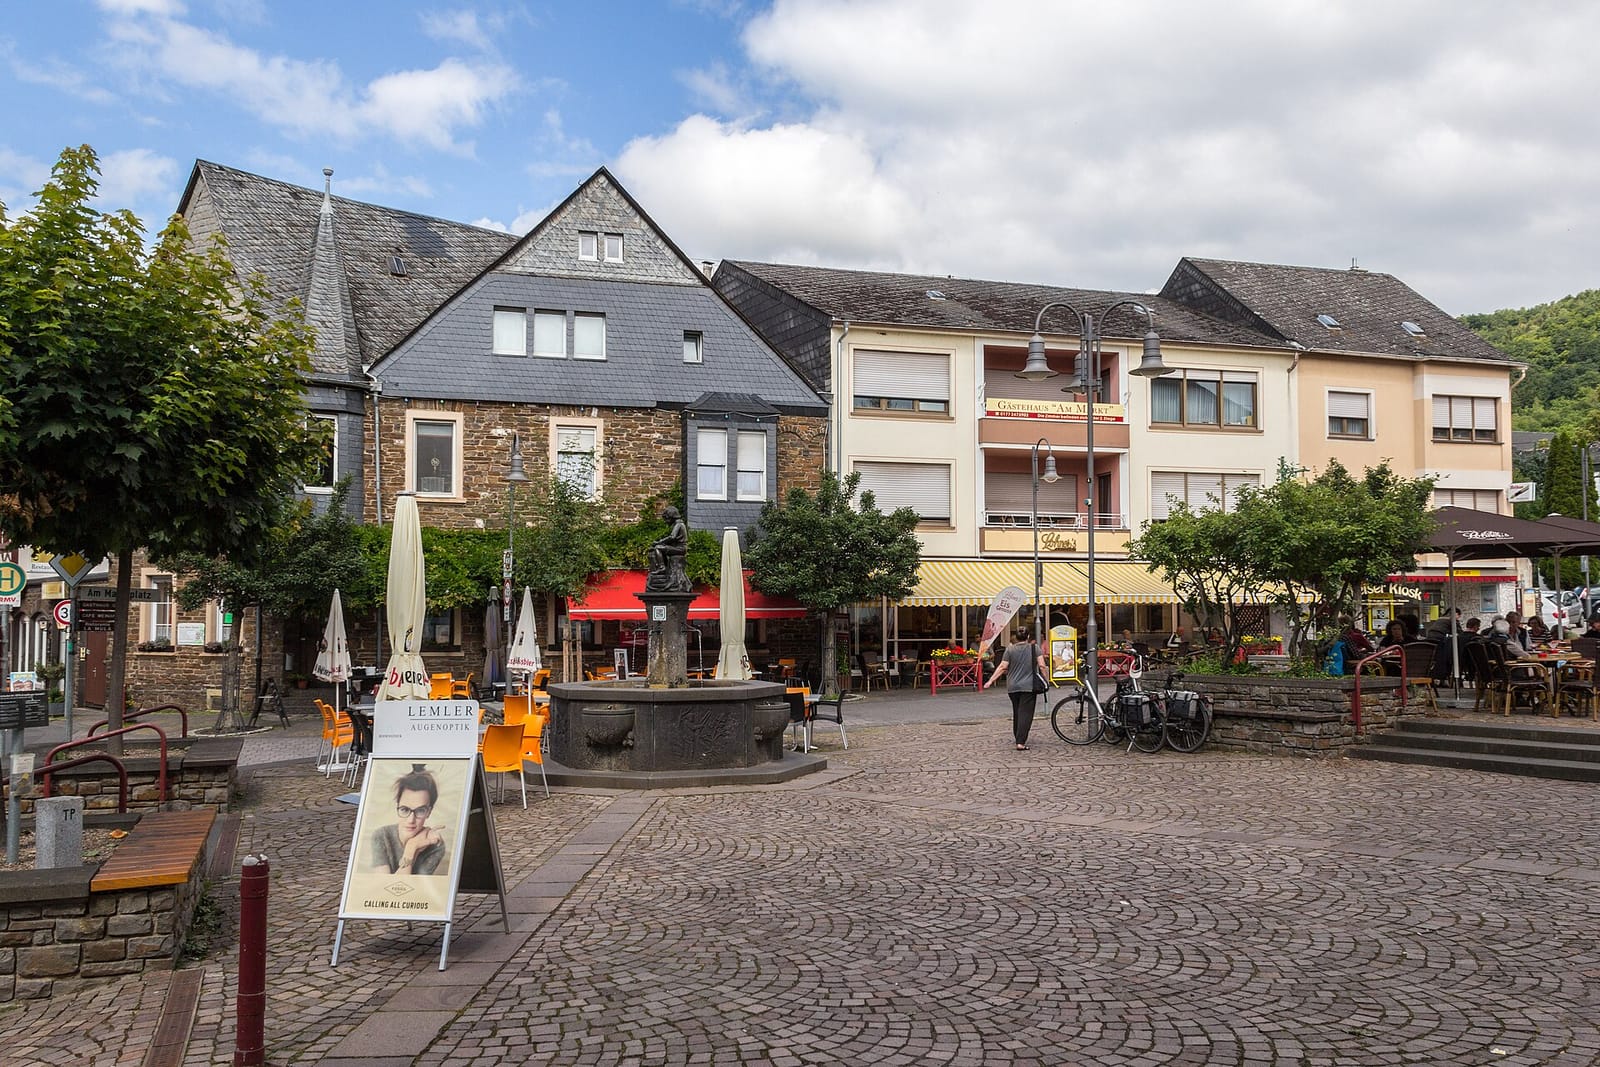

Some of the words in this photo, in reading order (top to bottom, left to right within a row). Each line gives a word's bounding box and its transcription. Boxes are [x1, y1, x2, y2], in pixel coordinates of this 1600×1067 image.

[1076, 404, 1114, 415] MRKT"
[87, 589, 101, 598] Am
[104, 589, 152, 599] Maplatz
[1389, 582, 1422, 601] Kiosk
[1000, 599, 1010, 609] Eis
[60, 607, 69, 619] 3
[408, 705, 473, 717] LEMLER
[410, 723, 470, 731] AUGENOPTIK
[63, 808, 76, 821] TP
[364, 900, 390, 908] CALLING
[390, 901, 400, 909] ALL
[402, 901, 429, 910] CURIOUS
